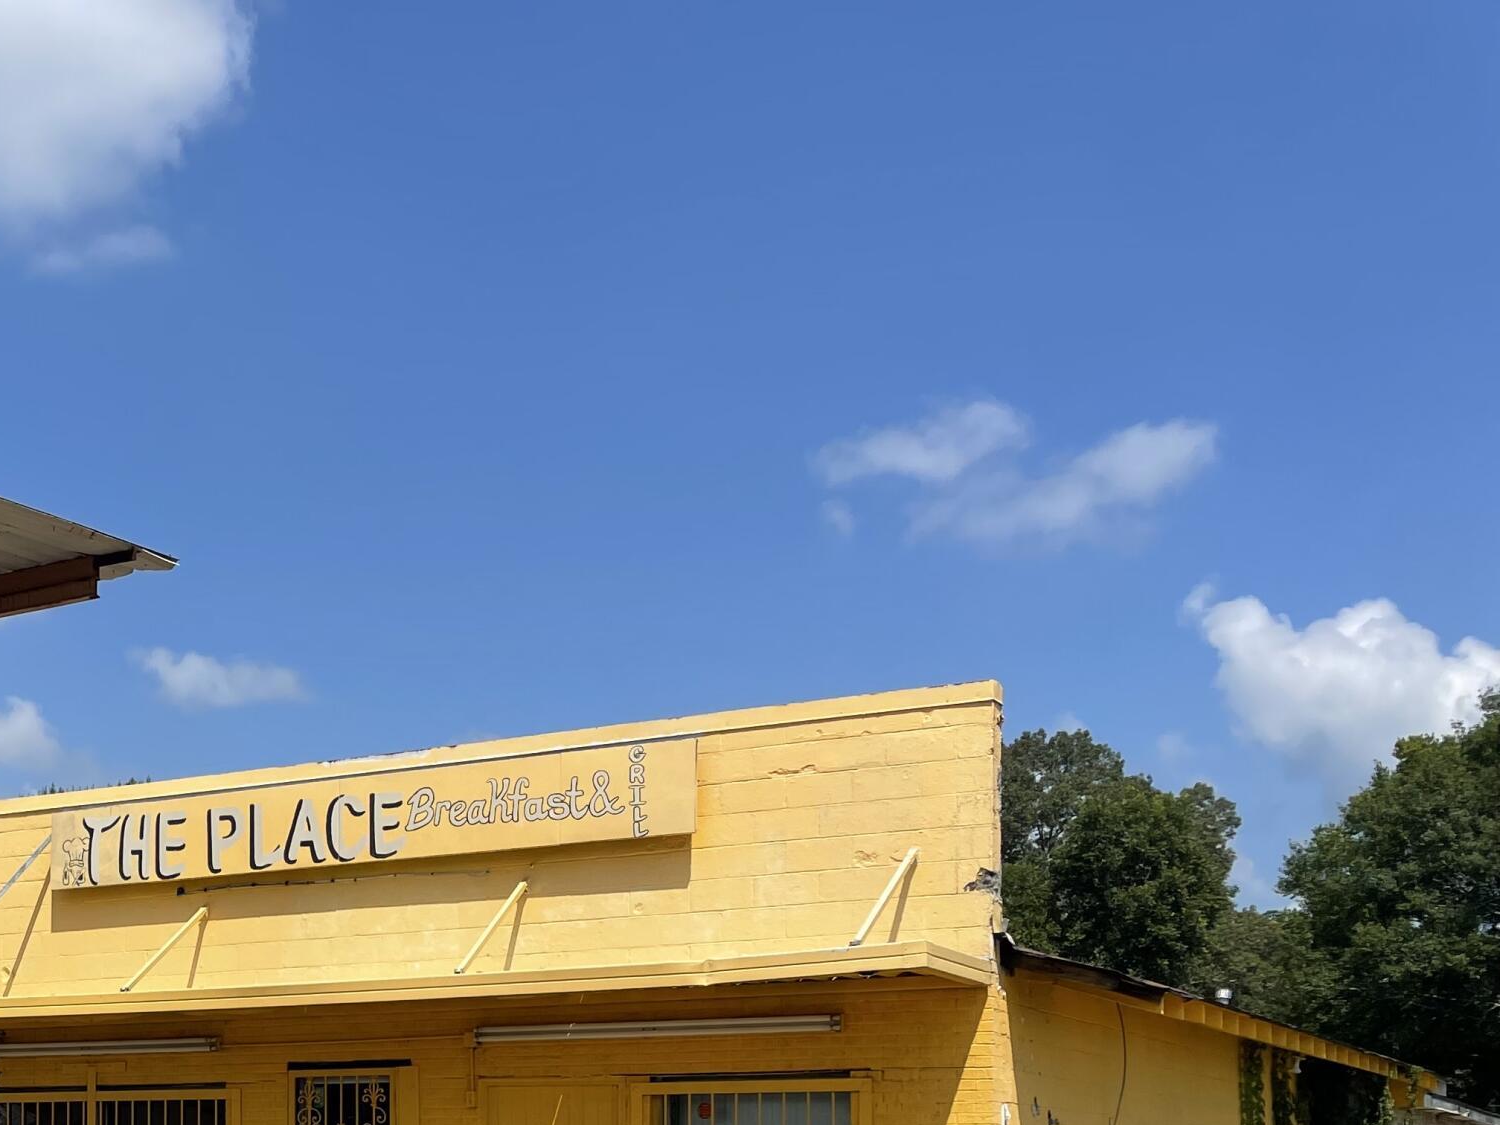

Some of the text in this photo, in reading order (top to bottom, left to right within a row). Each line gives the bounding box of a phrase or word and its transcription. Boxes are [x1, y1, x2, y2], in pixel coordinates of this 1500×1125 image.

[628, 745, 649, 838] GRILL
[82, 812, 187, 886] THE
[207, 792, 405, 873] PLACE
